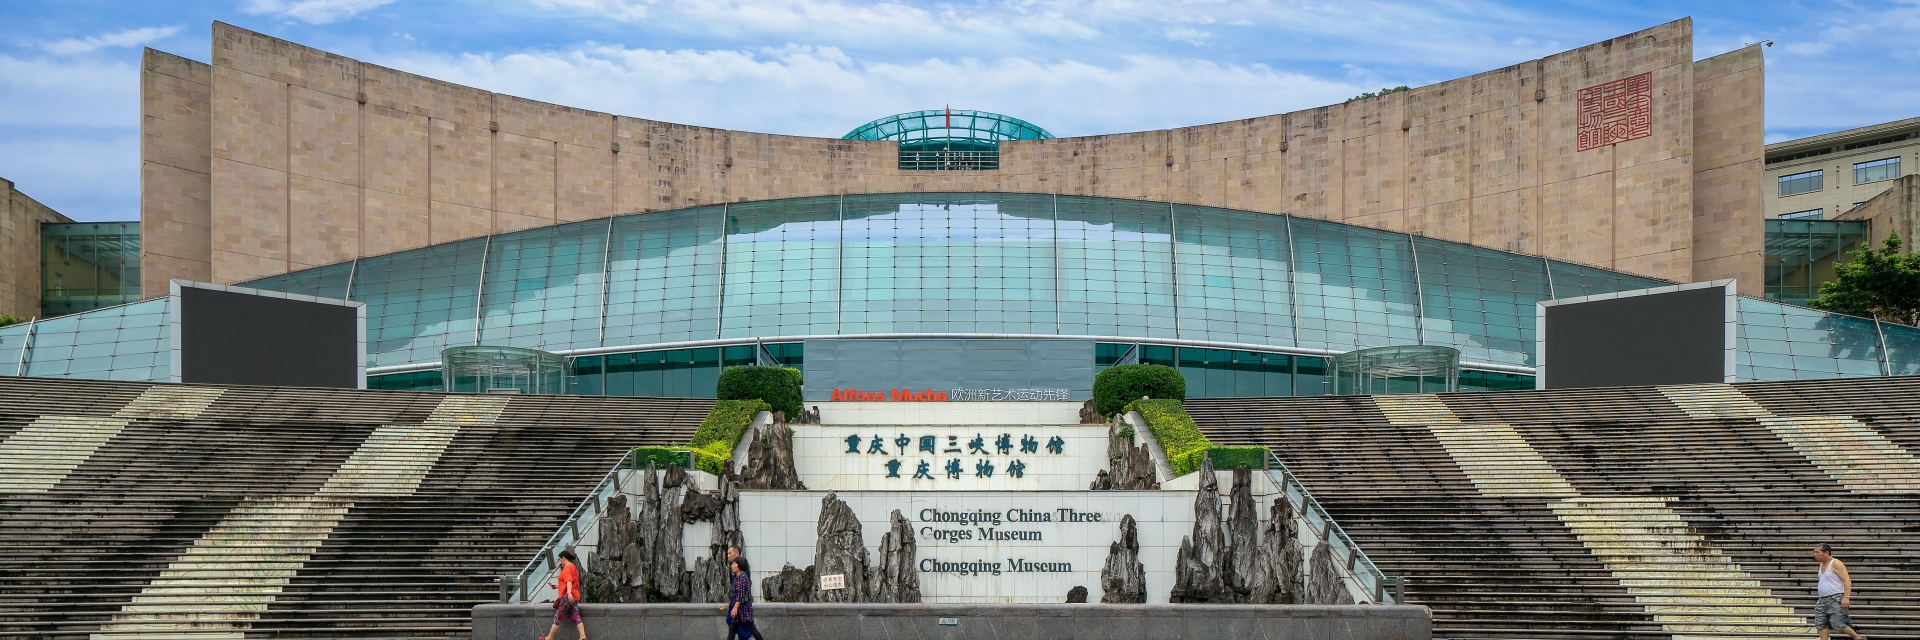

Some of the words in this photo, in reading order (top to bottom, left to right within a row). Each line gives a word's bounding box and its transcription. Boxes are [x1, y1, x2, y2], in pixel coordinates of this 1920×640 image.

[829, 388, 885, 402] Alfons
[891, 388, 947, 402] Mucha
[951, 388, 1069, 401] 欧洲新艺术运动先锋
[844, 433, 1065, 455] 重庆中国三峡博物馆
[884, 458, 1026, 480] 重庆博物馆
[919, 508, 1001, 526] Chongqing
[1006, 508, 1052, 523] China
[1056, 508, 1102, 523] Three
[978, 527, 1043, 541] Museum
[919, 558, 1001, 576] Chongqing
[1006, 558, 1073, 573] Museum
